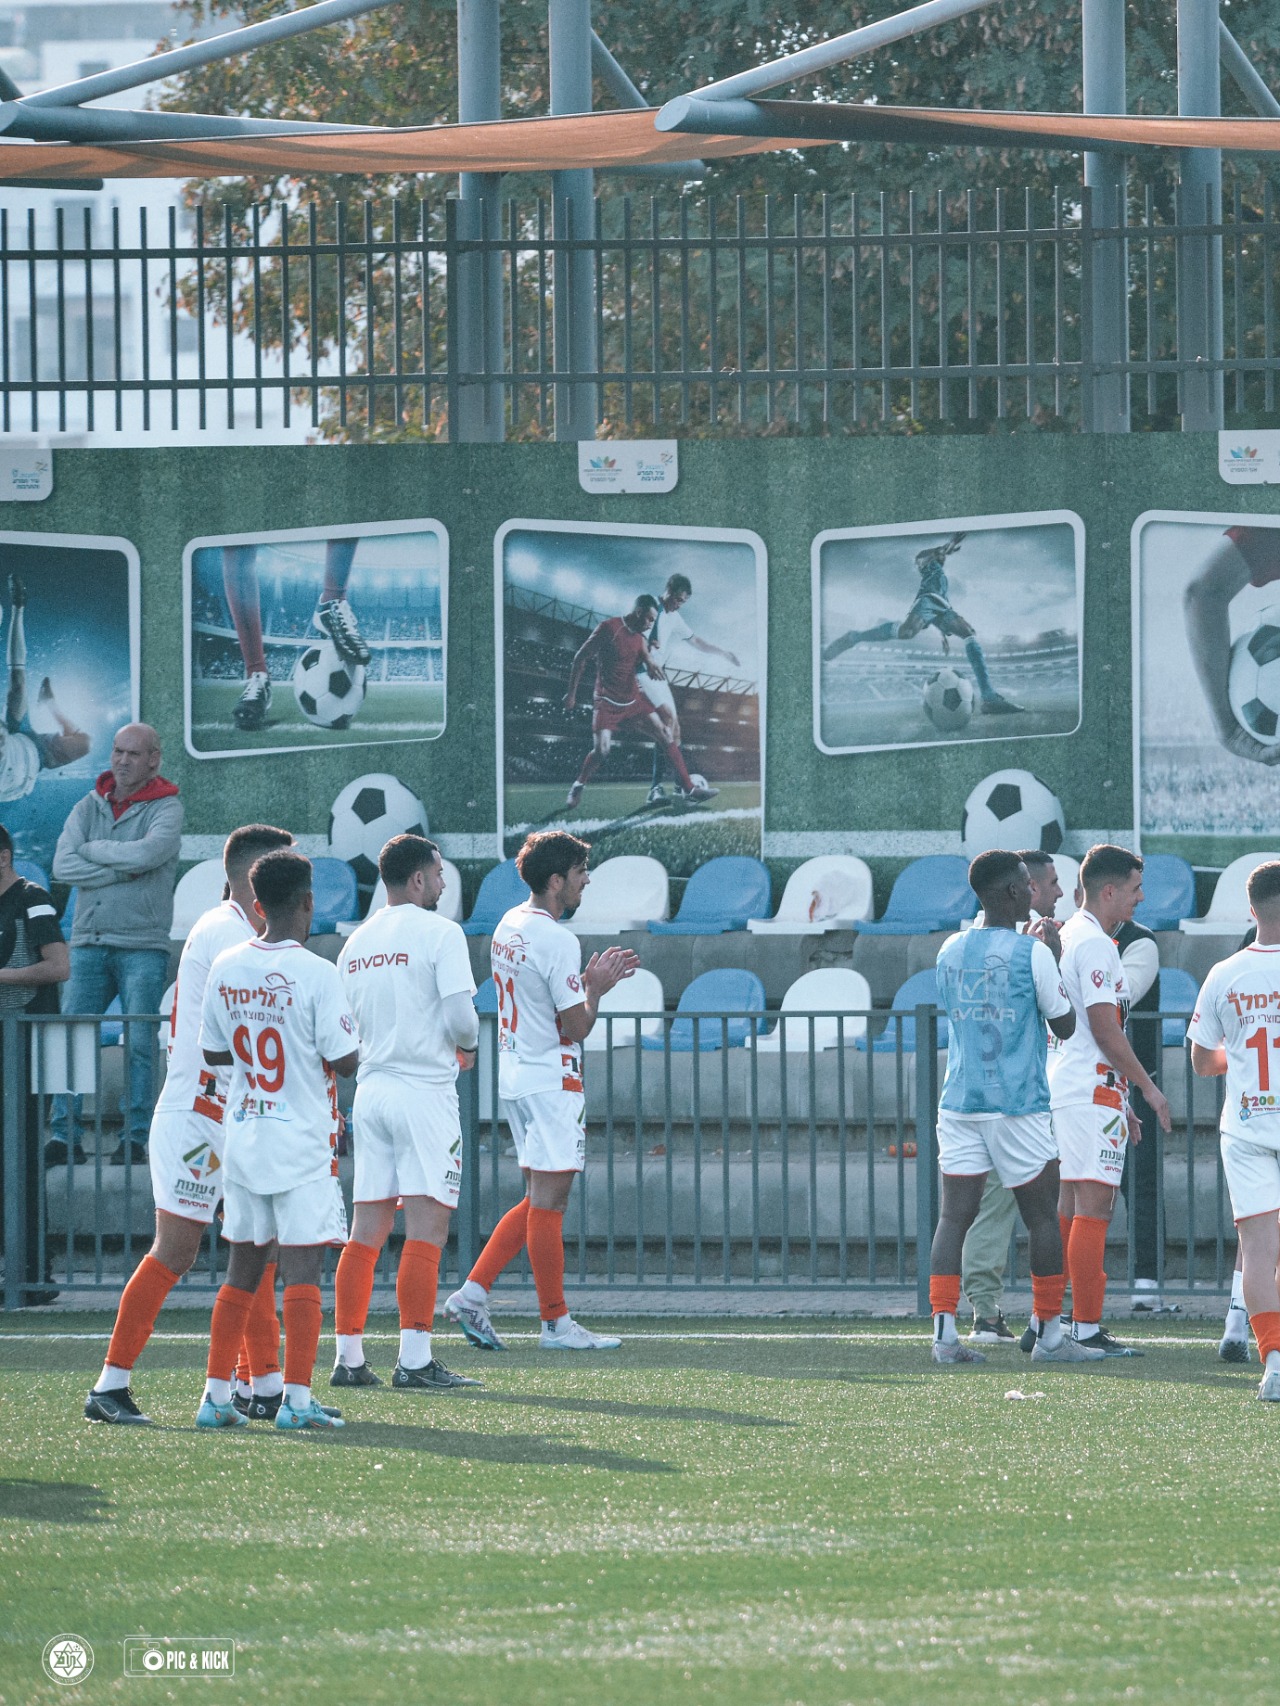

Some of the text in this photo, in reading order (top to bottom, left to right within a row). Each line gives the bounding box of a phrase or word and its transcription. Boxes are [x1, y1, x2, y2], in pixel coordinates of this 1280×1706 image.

[349, 952, 409, 974] GIVOVA
[233, 1024, 285, 1093] 99
[1251, 1095, 1280, 1107] 2000
[175, 1179, 208, 1195] עונות
[178, 1198, 209, 1209] GIVOVA
